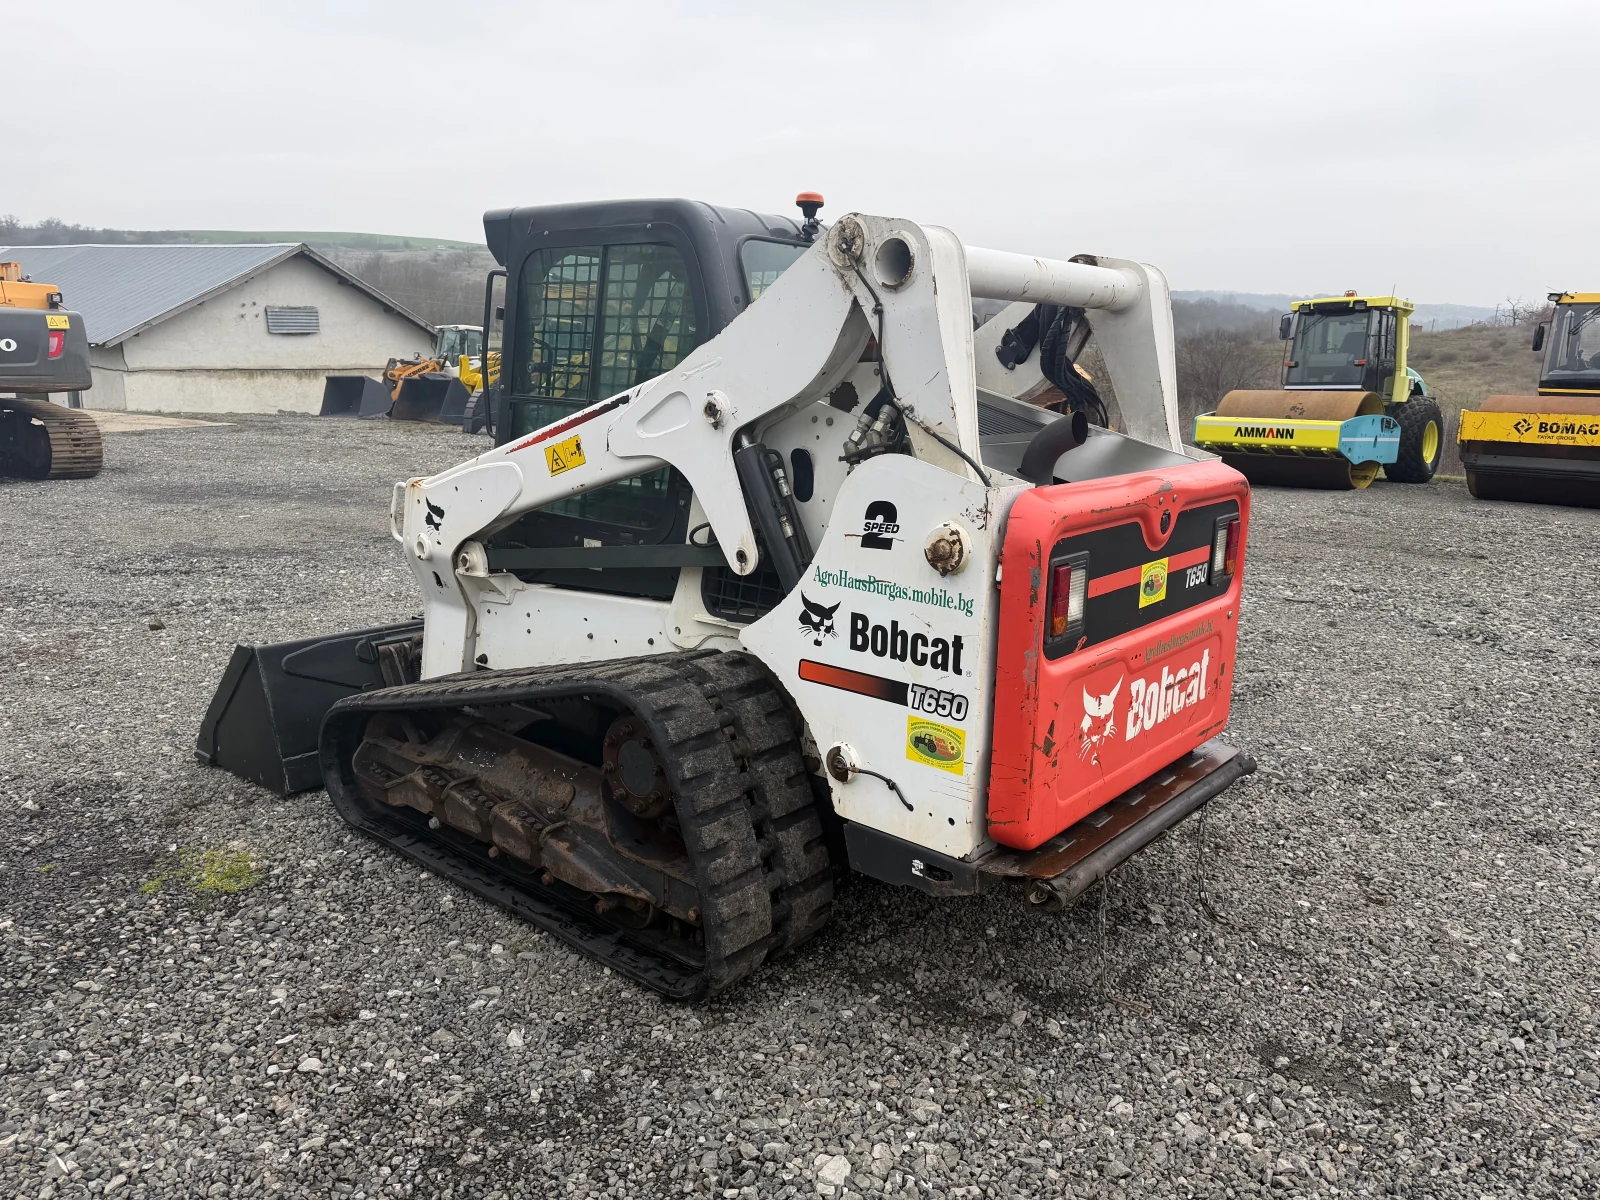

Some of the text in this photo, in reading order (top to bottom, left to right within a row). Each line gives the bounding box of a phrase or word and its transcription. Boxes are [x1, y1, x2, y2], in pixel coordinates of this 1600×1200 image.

[1234, 426, 1295, 439] AMMANN
[1538, 421, 1599, 436] BOMAG
[860, 500, 898, 551] 2
[863, 521, 900, 534] SPEED
[813, 565, 974, 617] AgroHausBurgas.mobile.bg
[1185, 562, 1208, 589] T650
[850, 611, 964, 676] Bobcat
[911, 683, 969, 722] T650
[1125, 648, 1210, 742] Bobcat
